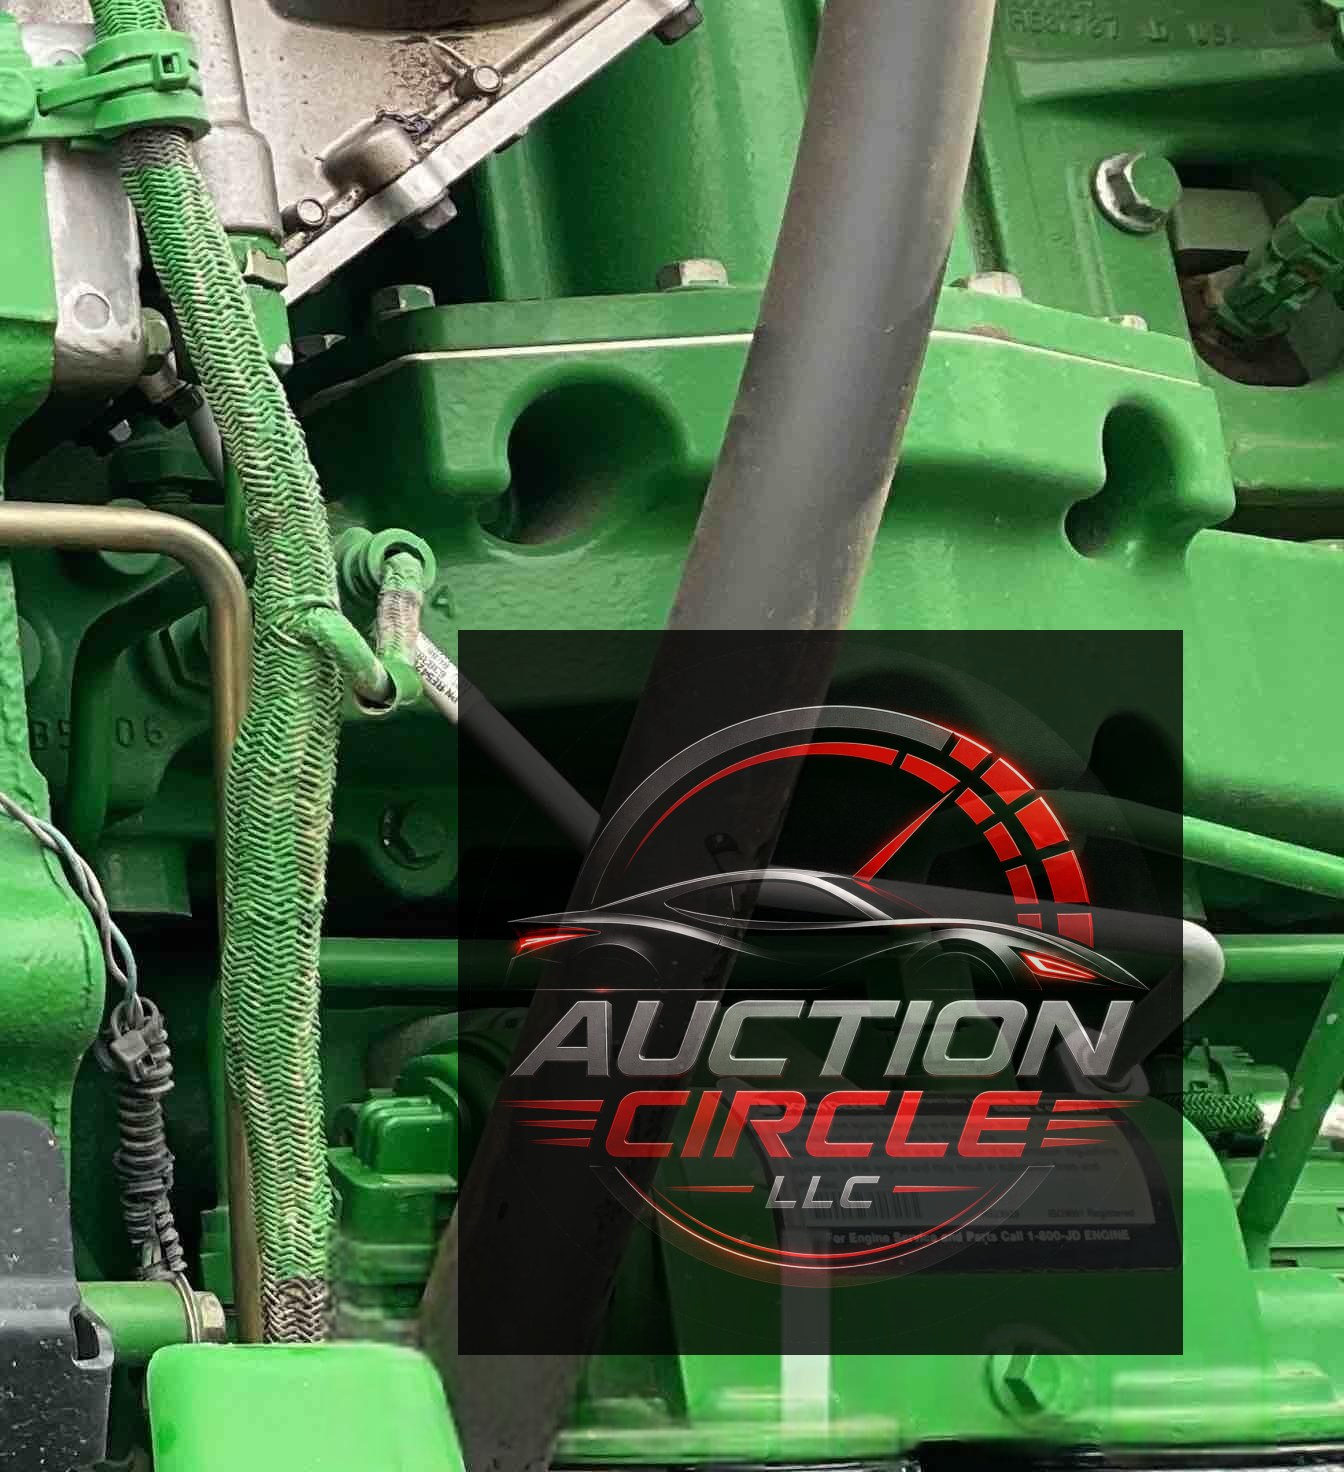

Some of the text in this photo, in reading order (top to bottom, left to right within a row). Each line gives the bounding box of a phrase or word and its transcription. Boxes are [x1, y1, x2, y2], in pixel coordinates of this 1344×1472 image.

[826, 1231, 847, 1244] For
[849, 1231, 891, 1246] Engine
[966, 1230, 997, 1244] Parts
[1000, 1230, 1025, 1243] Call
[1028, 1229, 1082, 1242] 1-800-JD
[1084, 1229, 1131, 1242] ENGINE
